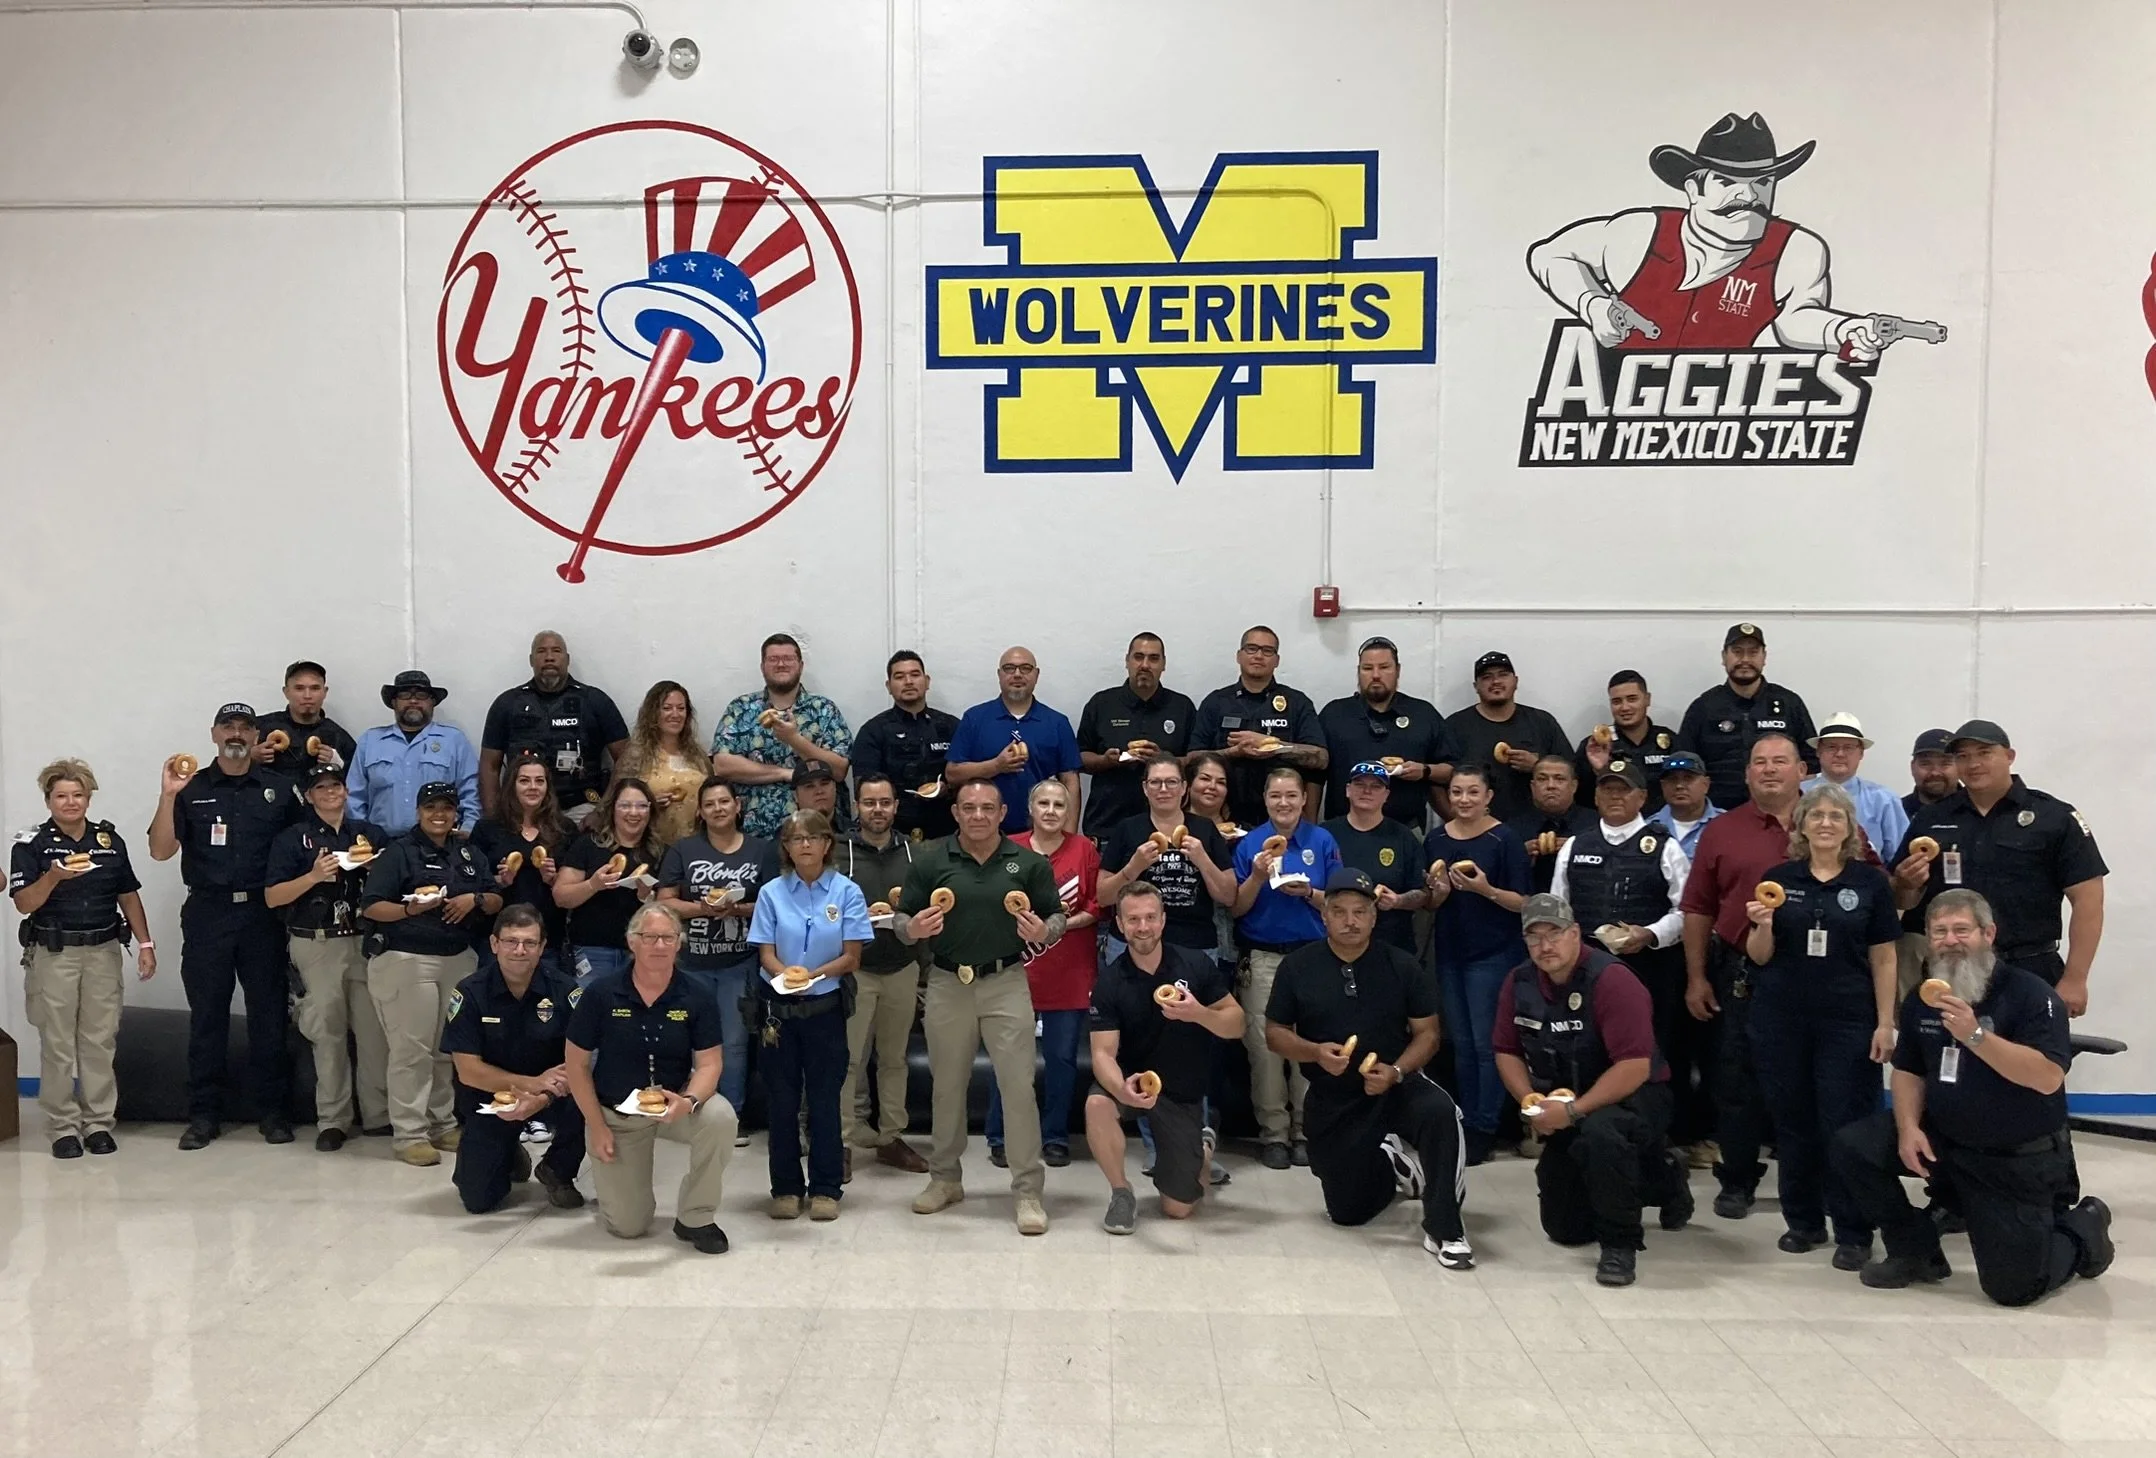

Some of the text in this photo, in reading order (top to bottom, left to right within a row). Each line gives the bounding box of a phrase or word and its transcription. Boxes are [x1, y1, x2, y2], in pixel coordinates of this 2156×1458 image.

[1720, 276, 1758, 306] NM
[968, 283, 1391, 346] WOLVERINES
[1718, 299, 1751, 317] STATE
[444, 251, 843, 470] Yankees
[1536, 326, 1868, 418] AGGIES
[1529, 419, 1854, 461] NEW MEXICO STATE
[552, 718, 578, 726] NMCD
[1261, 719, 1288, 727] NMCD
[1757, 720, 1786, 729] NMCD
[1644, 755, 1670, 765] NMC
[1573, 854, 1603, 864] NMCD
[688, 860, 758, 884] Blondie
[689, 942, 709, 955] NEW
[710, 942, 734, 954] YORK
